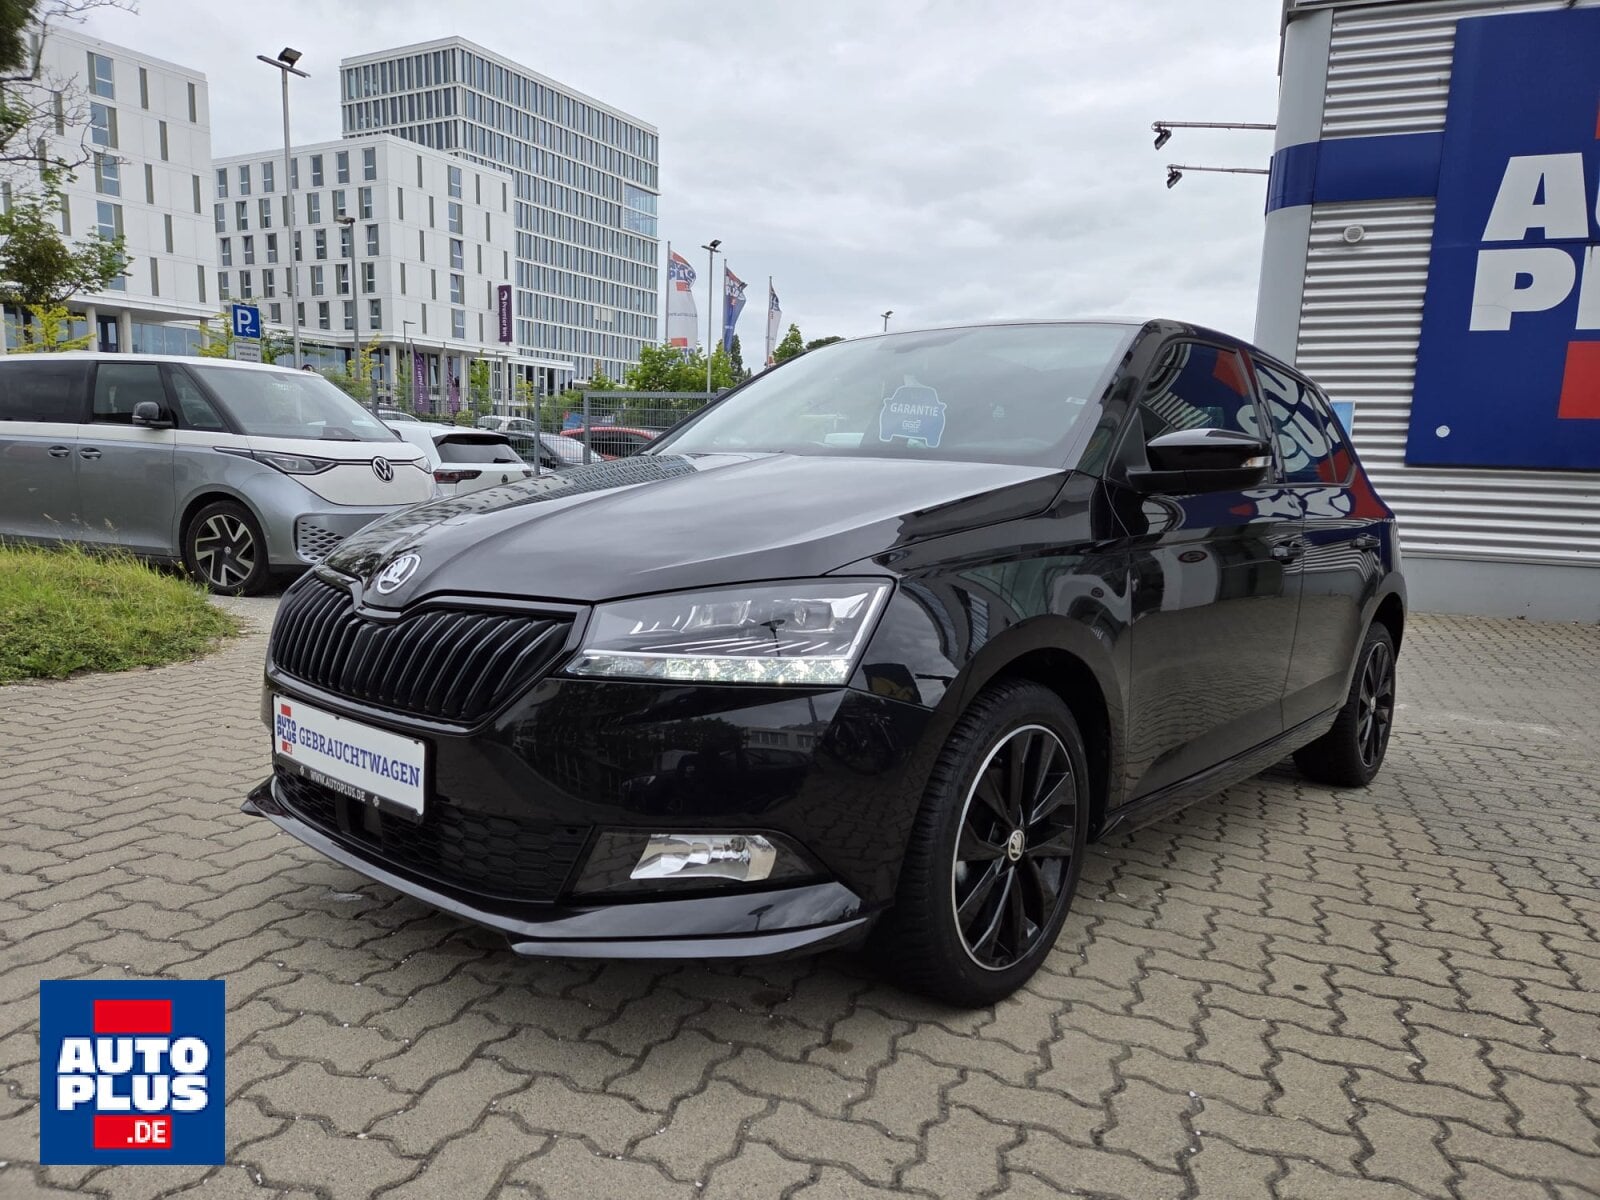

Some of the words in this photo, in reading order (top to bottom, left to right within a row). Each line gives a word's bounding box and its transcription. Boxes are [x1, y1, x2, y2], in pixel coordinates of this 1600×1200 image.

[1481, 152, 1600, 242] A
[1469, 246, 1600, 332] P
[237, 309, 252, 333] P
[890, 402, 939, 417] GARANTIE
[277, 714, 297, 732] AUTO
[277, 725, 297, 744] PLUS
[299, 727, 421, 788] GEBRAUCHTWAGEN
[310, 769, 366, 802] WWW.AUTOPLUS.DE
